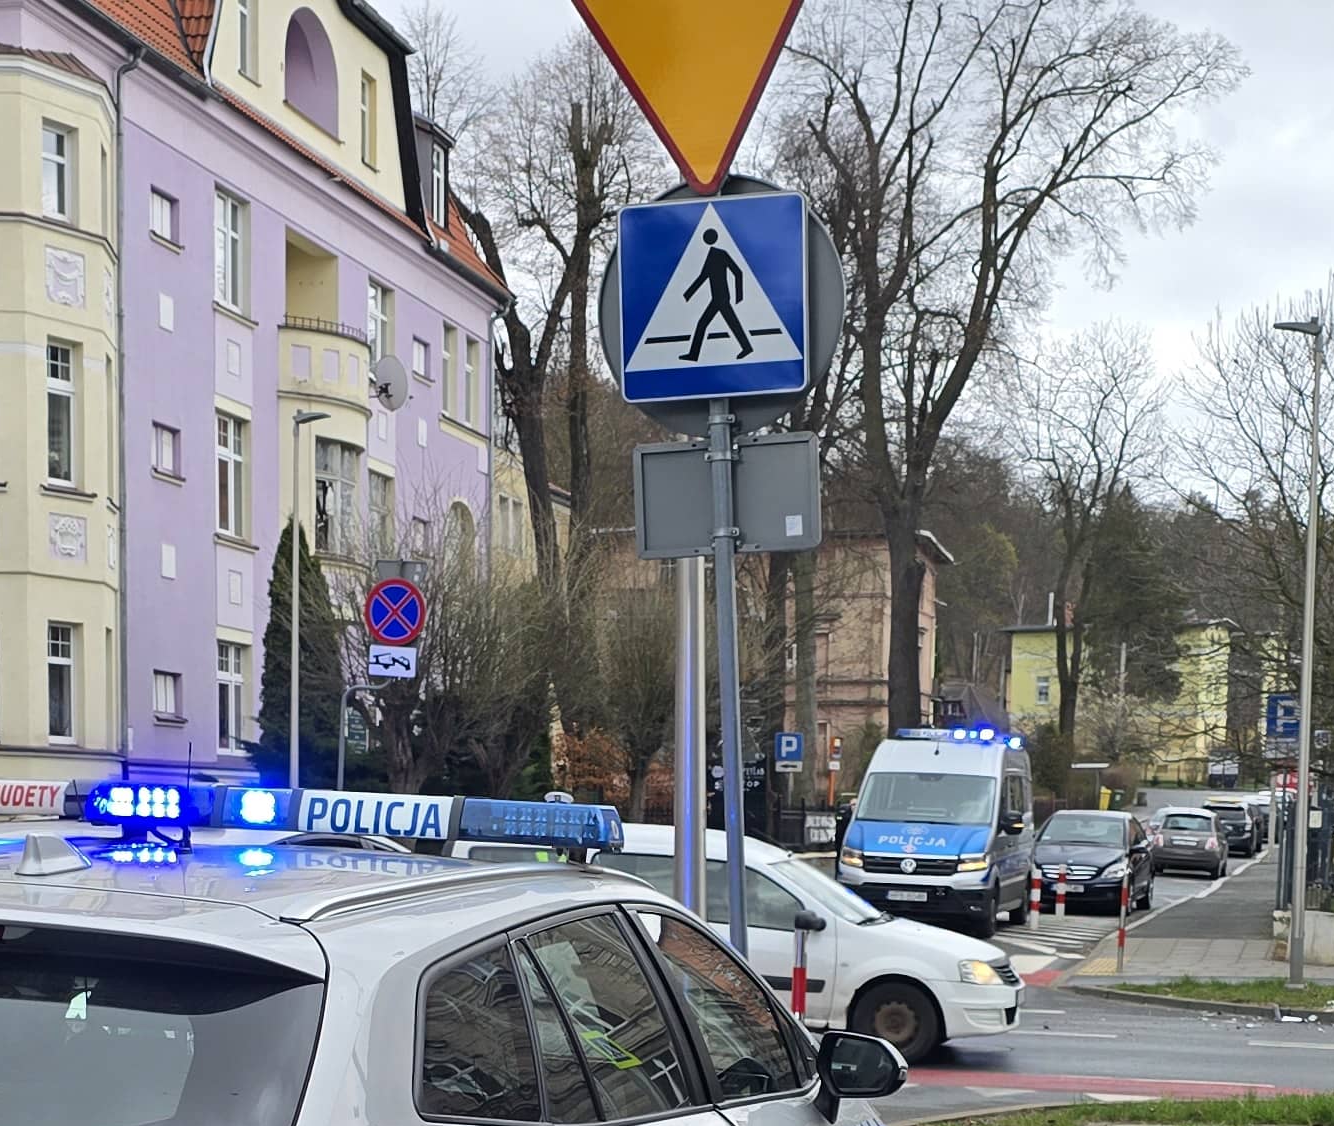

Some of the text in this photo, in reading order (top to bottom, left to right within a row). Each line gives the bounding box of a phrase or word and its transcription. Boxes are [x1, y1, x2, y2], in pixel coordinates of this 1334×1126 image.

[780, 735, 798, 758] P
[306, 797, 441, 838] POLICJA
[878, 834, 947, 848] POLICJA
